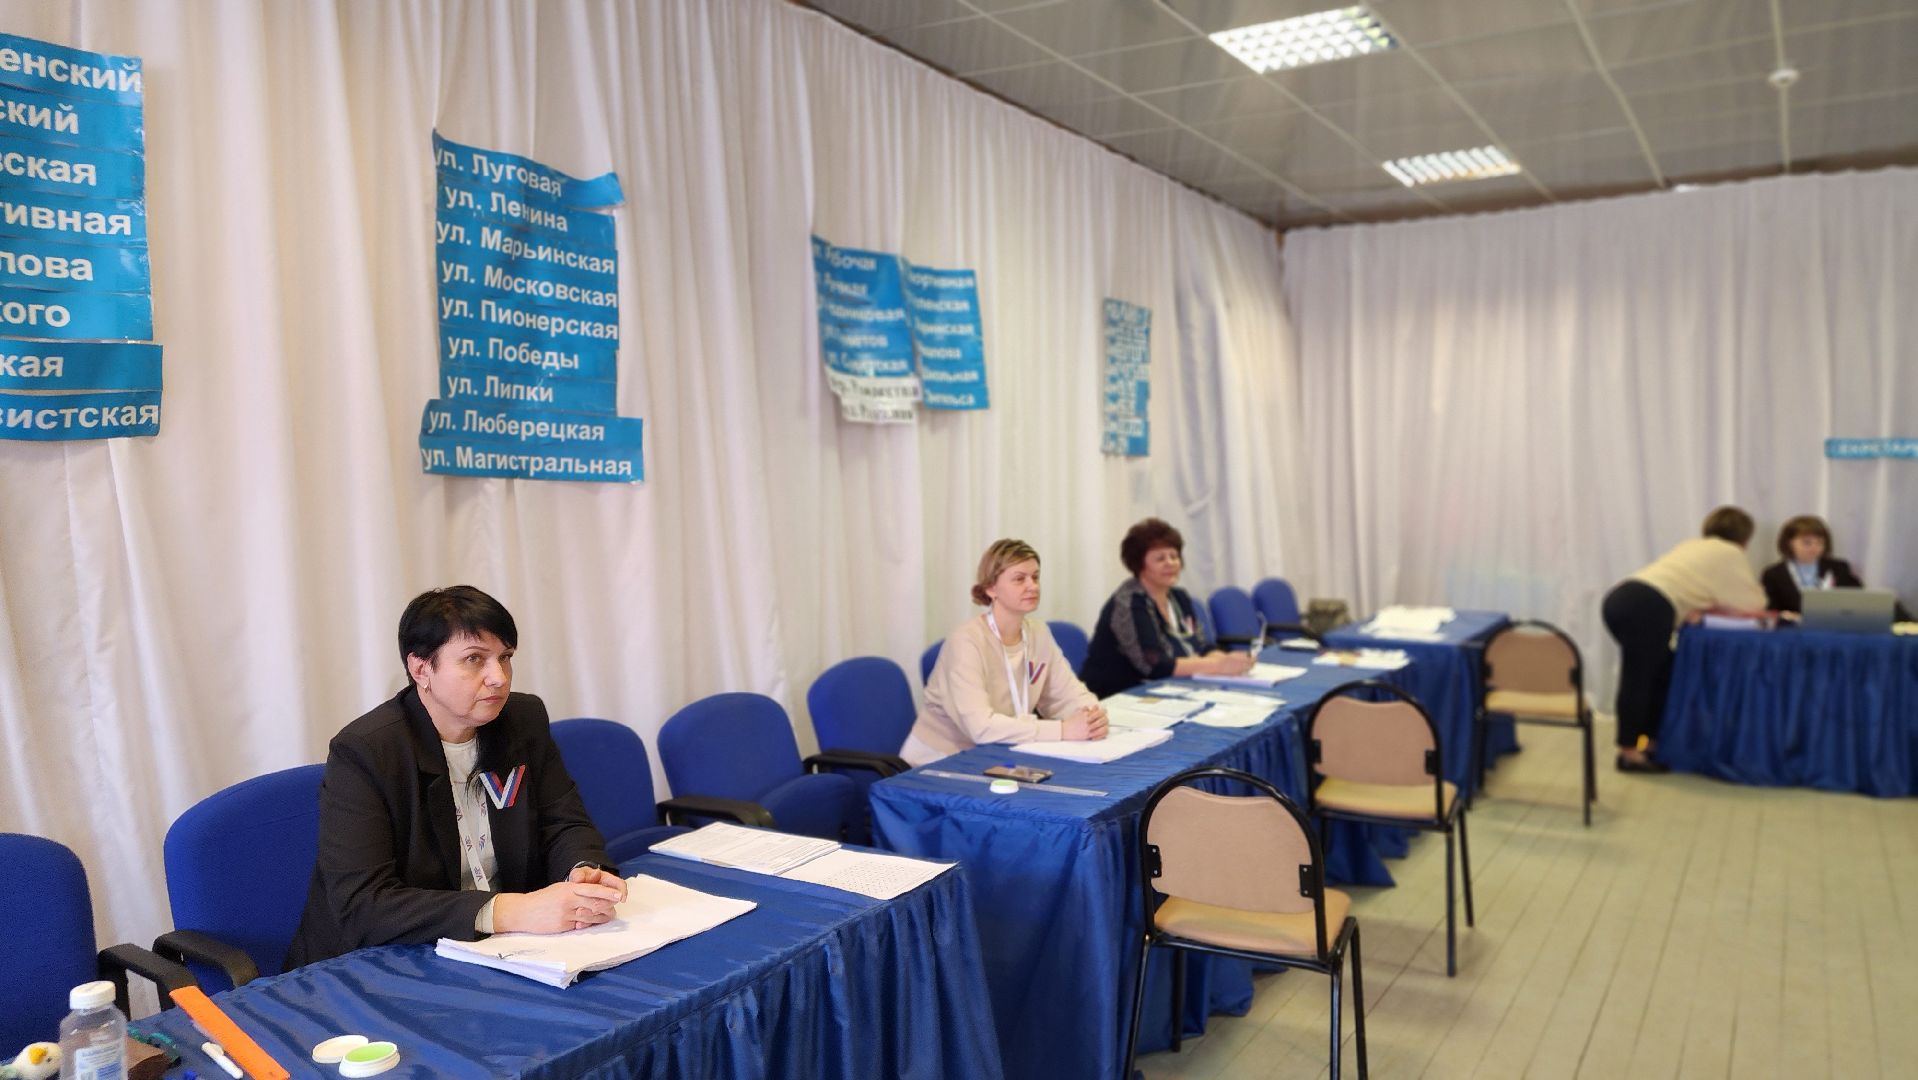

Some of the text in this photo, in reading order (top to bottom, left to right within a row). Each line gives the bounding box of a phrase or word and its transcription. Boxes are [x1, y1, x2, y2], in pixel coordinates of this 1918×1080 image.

[0, 97, 80, 135] кий
[0, 151, 98, 187] ская
[472, 153, 562, 197] Луговая
[0, 201, 132, 236] ивная
[445, 184, 569, 233] ул. Ленина
[436, 220, 616, 275] ул. Марьинская
[442, 260, 618, 308] ул. Московская
[0, 301, 71, 328] ого
[442, 296, 619, 340] ул. Пионерская
[448, 335, 580, 371] ул. Победы
[447, 374, 554, 403] ул. Липки
[0, 403, 160, 430] истская
[429, 409, 605, 442] ул. Люберецкая
[422, 446, 633, 477] ул. Магистральная
